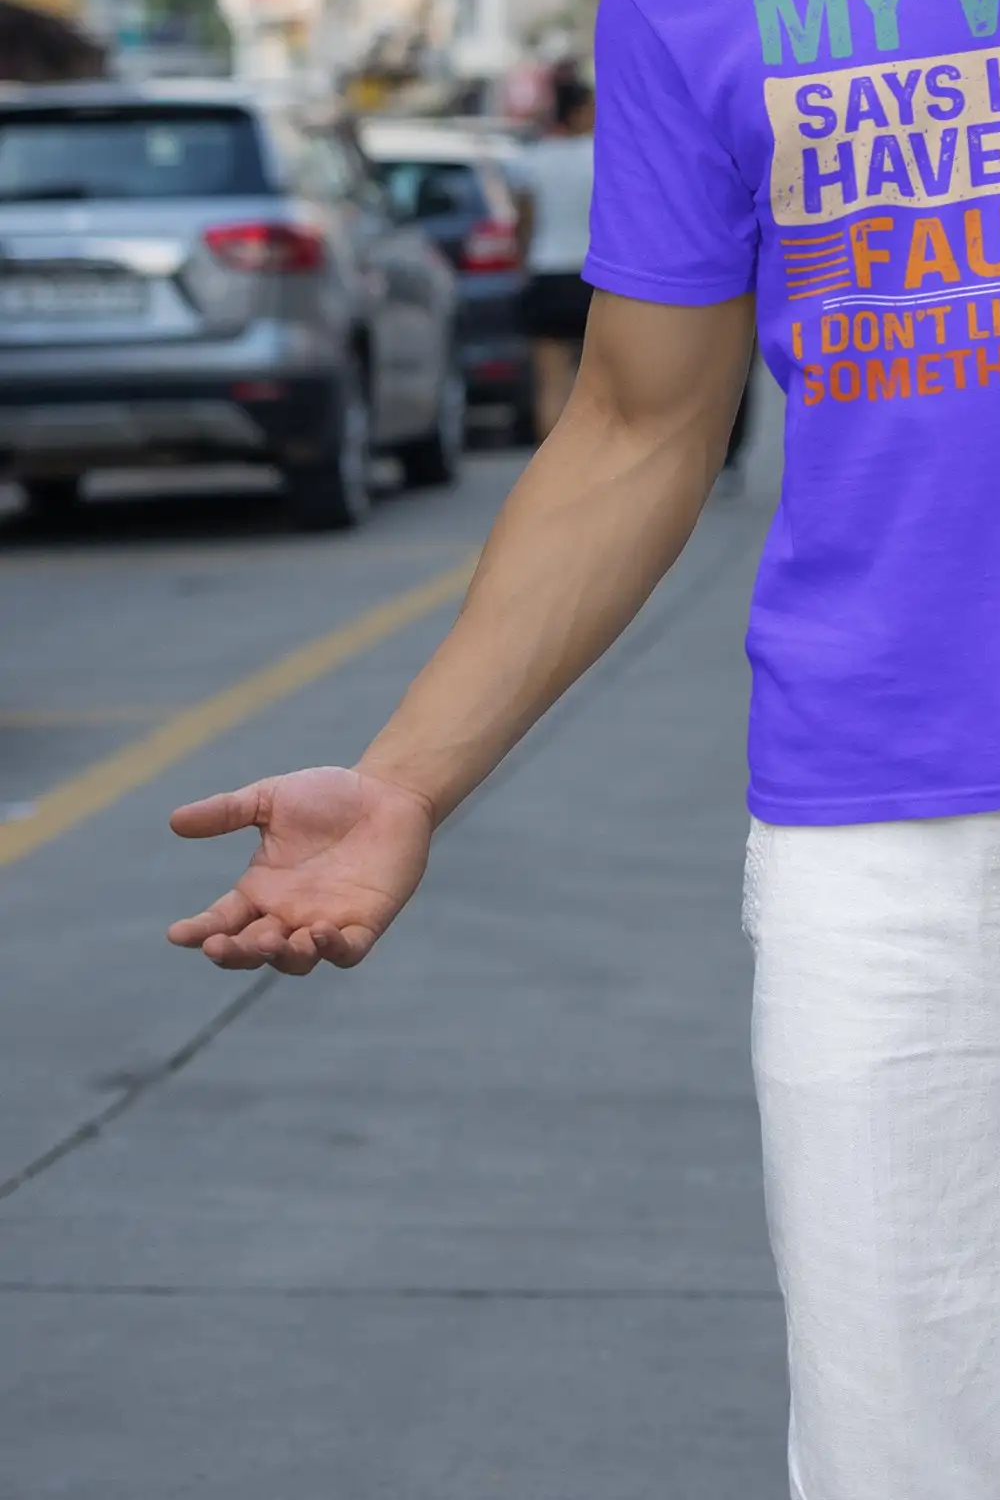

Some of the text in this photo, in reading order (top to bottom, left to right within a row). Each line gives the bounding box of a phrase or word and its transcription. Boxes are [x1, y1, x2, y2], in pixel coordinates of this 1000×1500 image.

[795, 64, 966, 139] SAYS
[792, 322, 802, 359] I
[822, 306, 951, 354] DON'T
